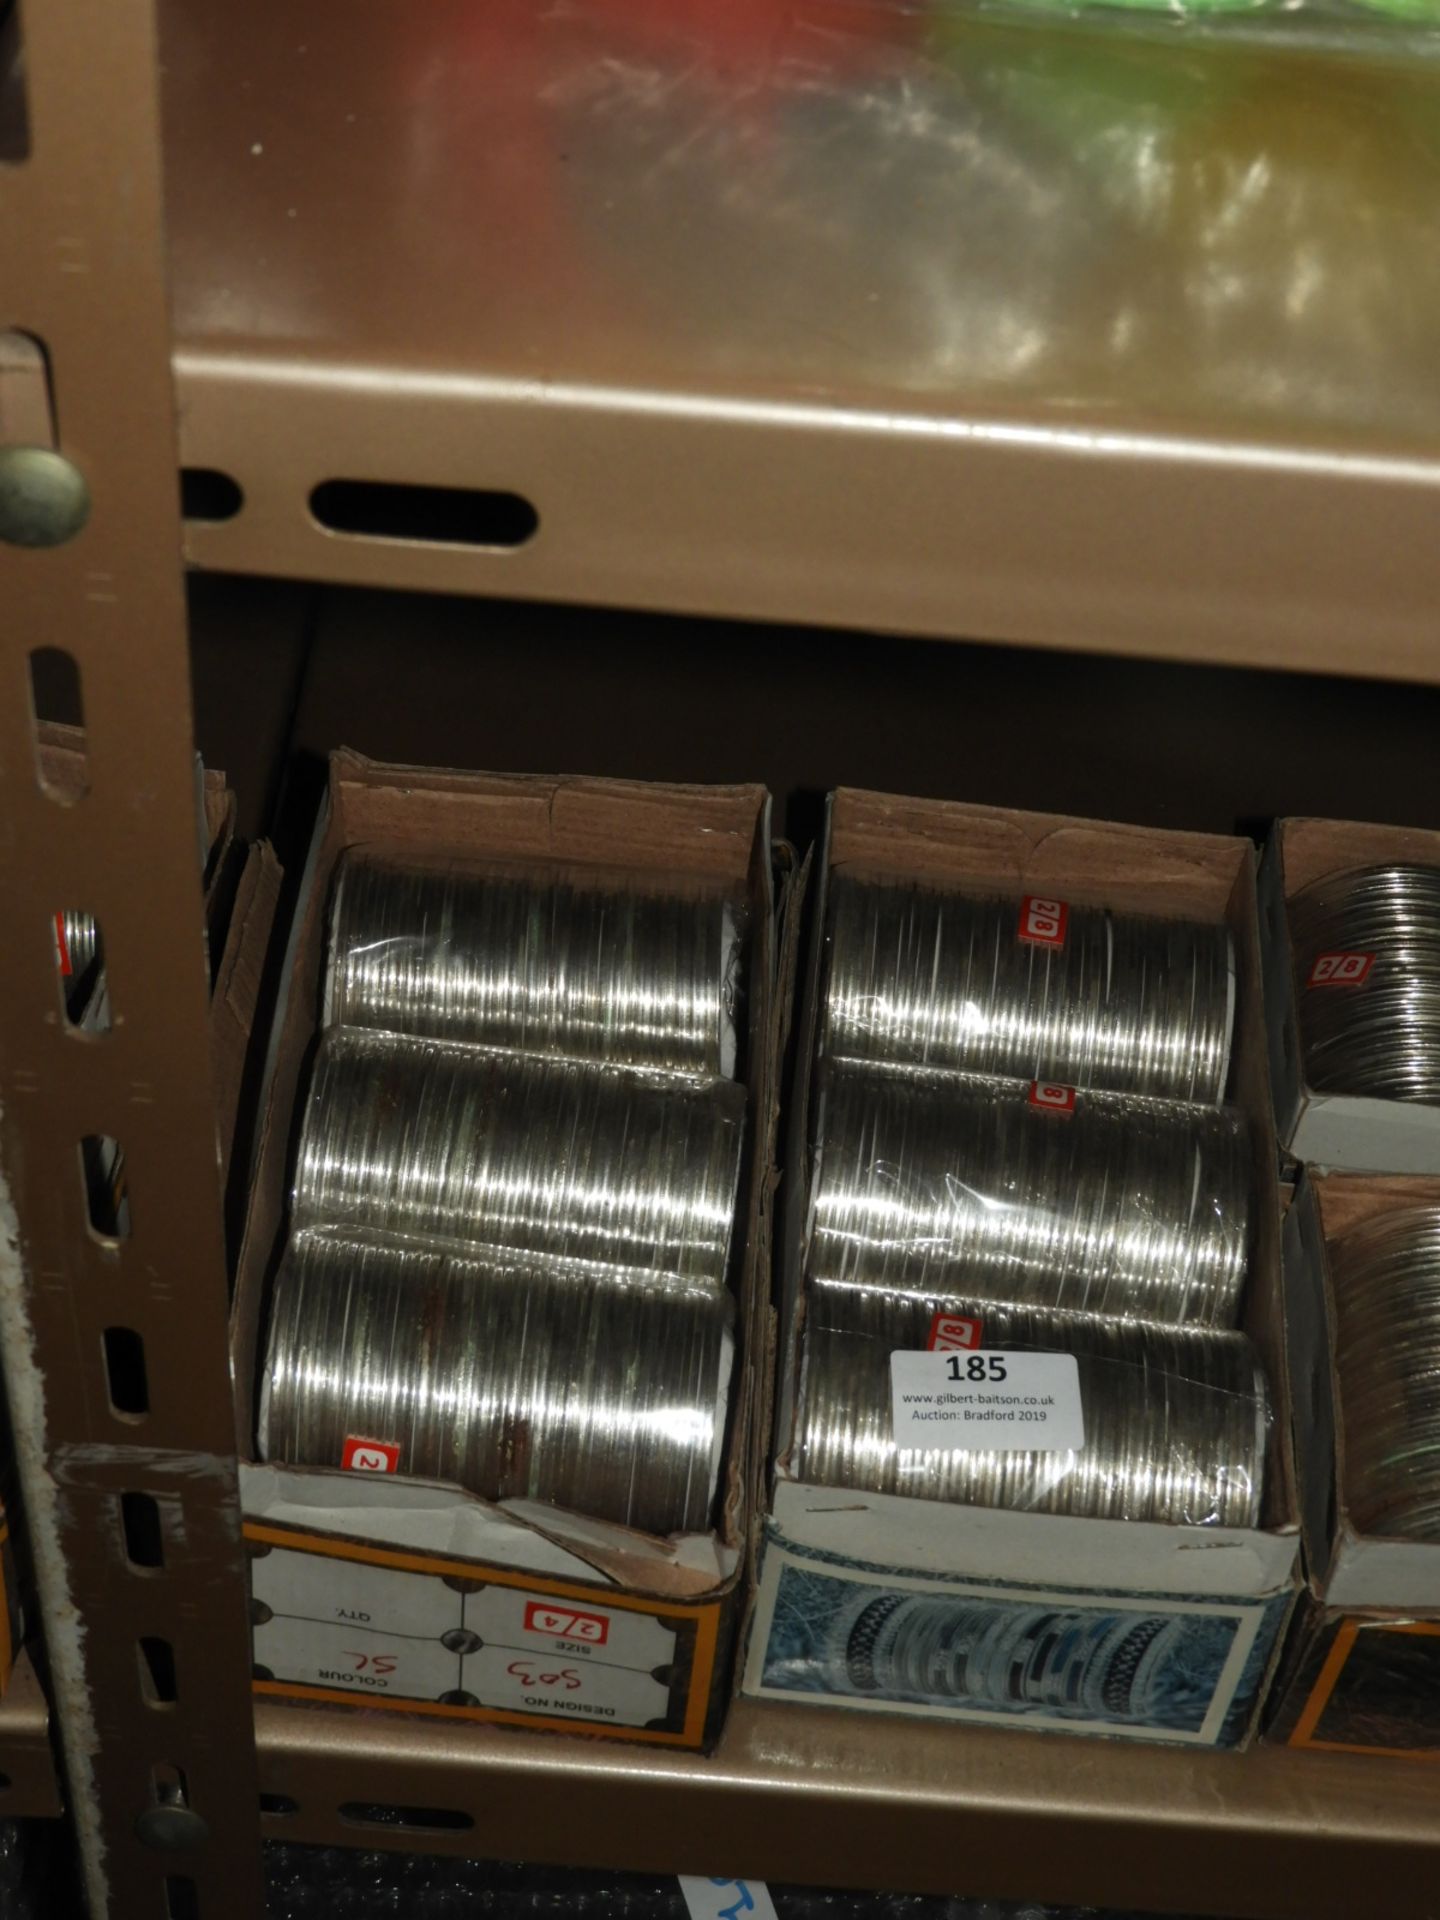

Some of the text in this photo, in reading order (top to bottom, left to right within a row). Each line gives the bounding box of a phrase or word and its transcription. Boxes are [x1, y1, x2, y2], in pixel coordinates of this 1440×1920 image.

[1318, 957, 1361, 978] 2/8
[946, 1355, 1008, 1382] 185
[902, 1392, 1055, 1407] www.gilbert-baitson.co.uk
[911, 1409, 1047, 1422] Auction: Bradford 2019
[543, 1615, 596, 1636] 2/4
[555, 1640, 592, 1655] SIZE
[317, 1668, 389, 1688] COLOUR
[520, 1694, 616, 1717] DESIGN NO.
